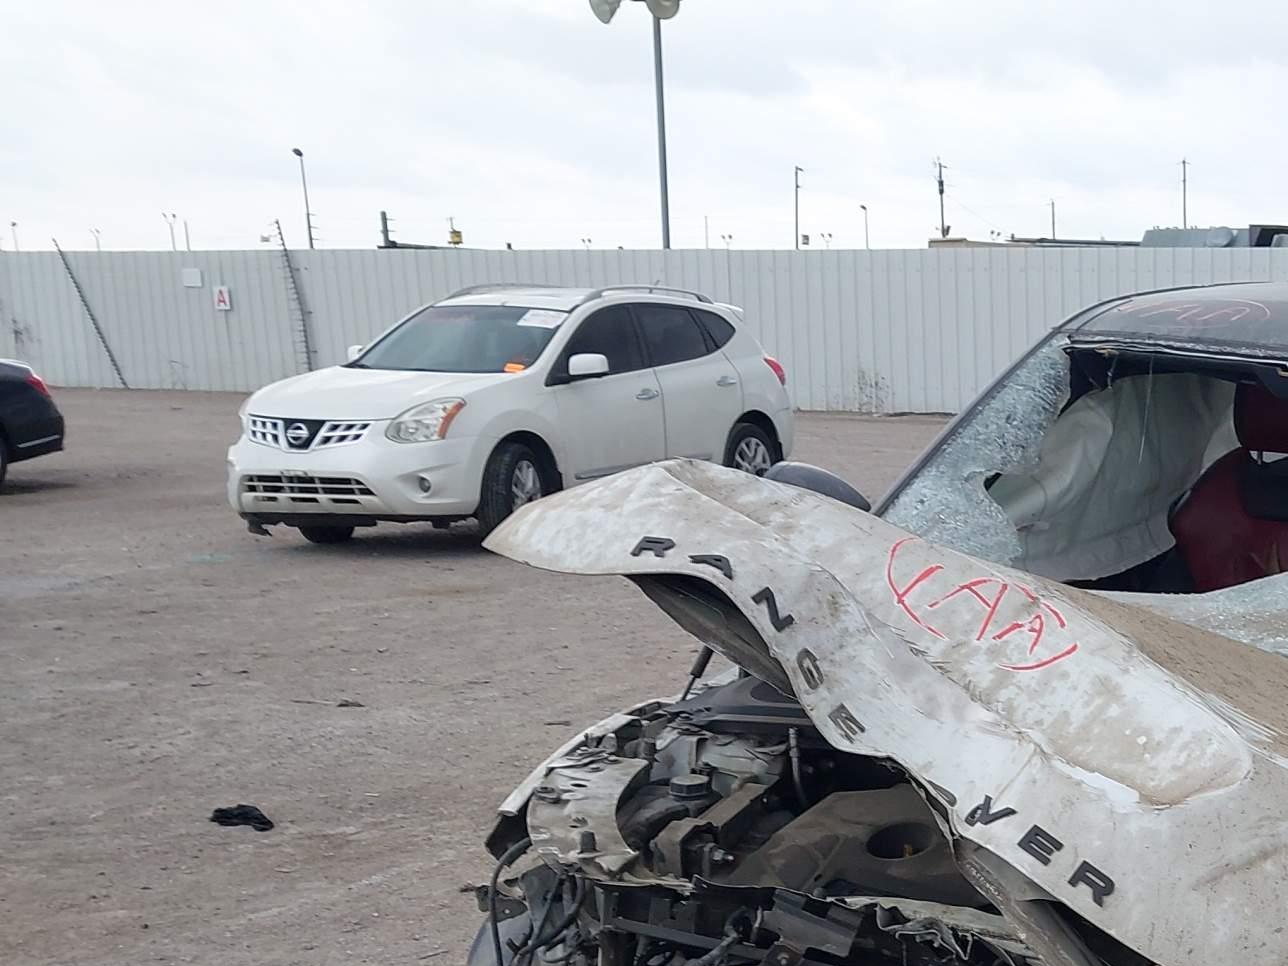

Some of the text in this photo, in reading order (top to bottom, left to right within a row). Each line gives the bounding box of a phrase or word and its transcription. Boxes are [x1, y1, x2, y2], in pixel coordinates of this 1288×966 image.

[216, 289, 228, 307] A
[630, 536, 866, 744] RANGE
[896, 563, 1046, 657] IAA
